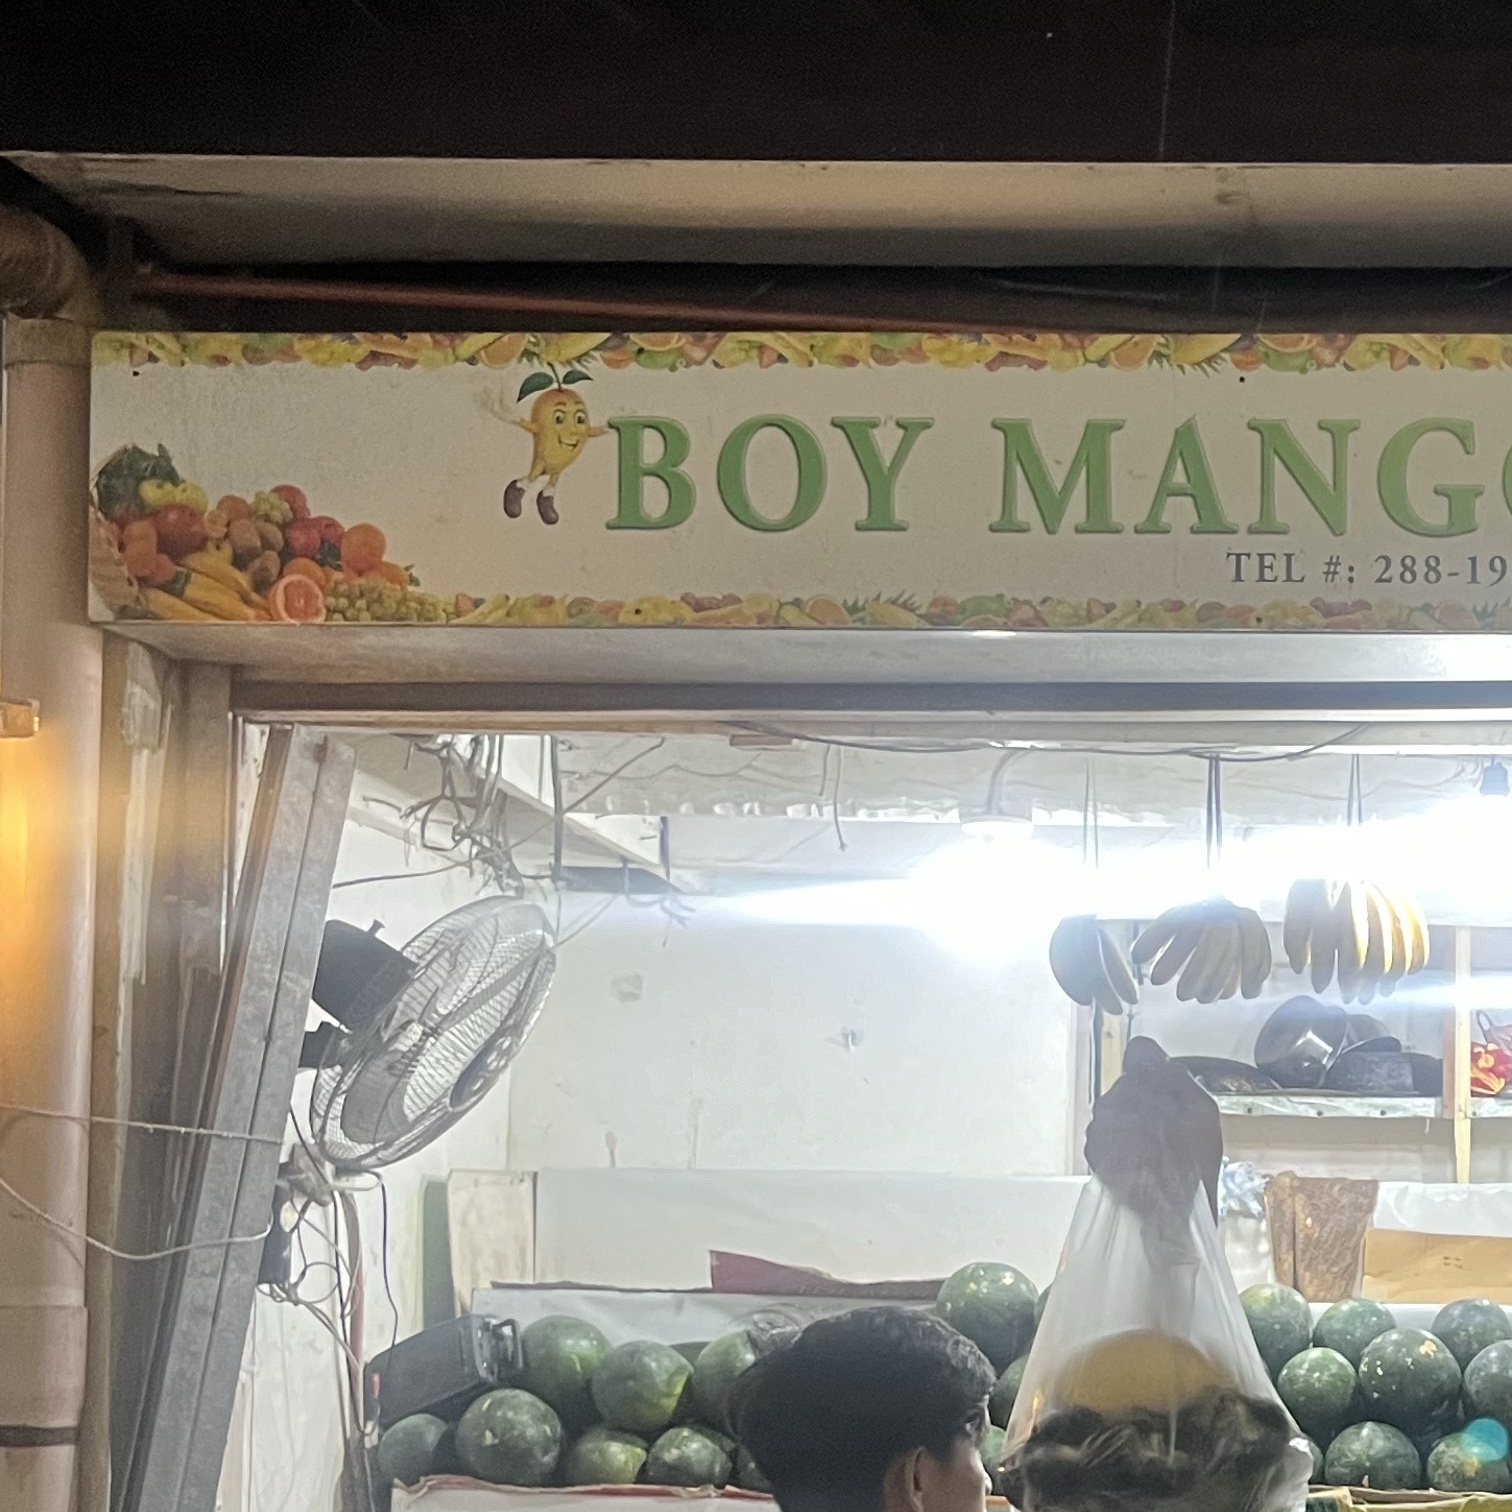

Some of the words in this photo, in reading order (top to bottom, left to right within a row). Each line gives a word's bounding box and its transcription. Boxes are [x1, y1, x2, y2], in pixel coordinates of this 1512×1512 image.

[605, 414, 935, 532] BOY
[1226, 552, 1305, 583] TEL
[1322, 554, 1355, 584] #:
